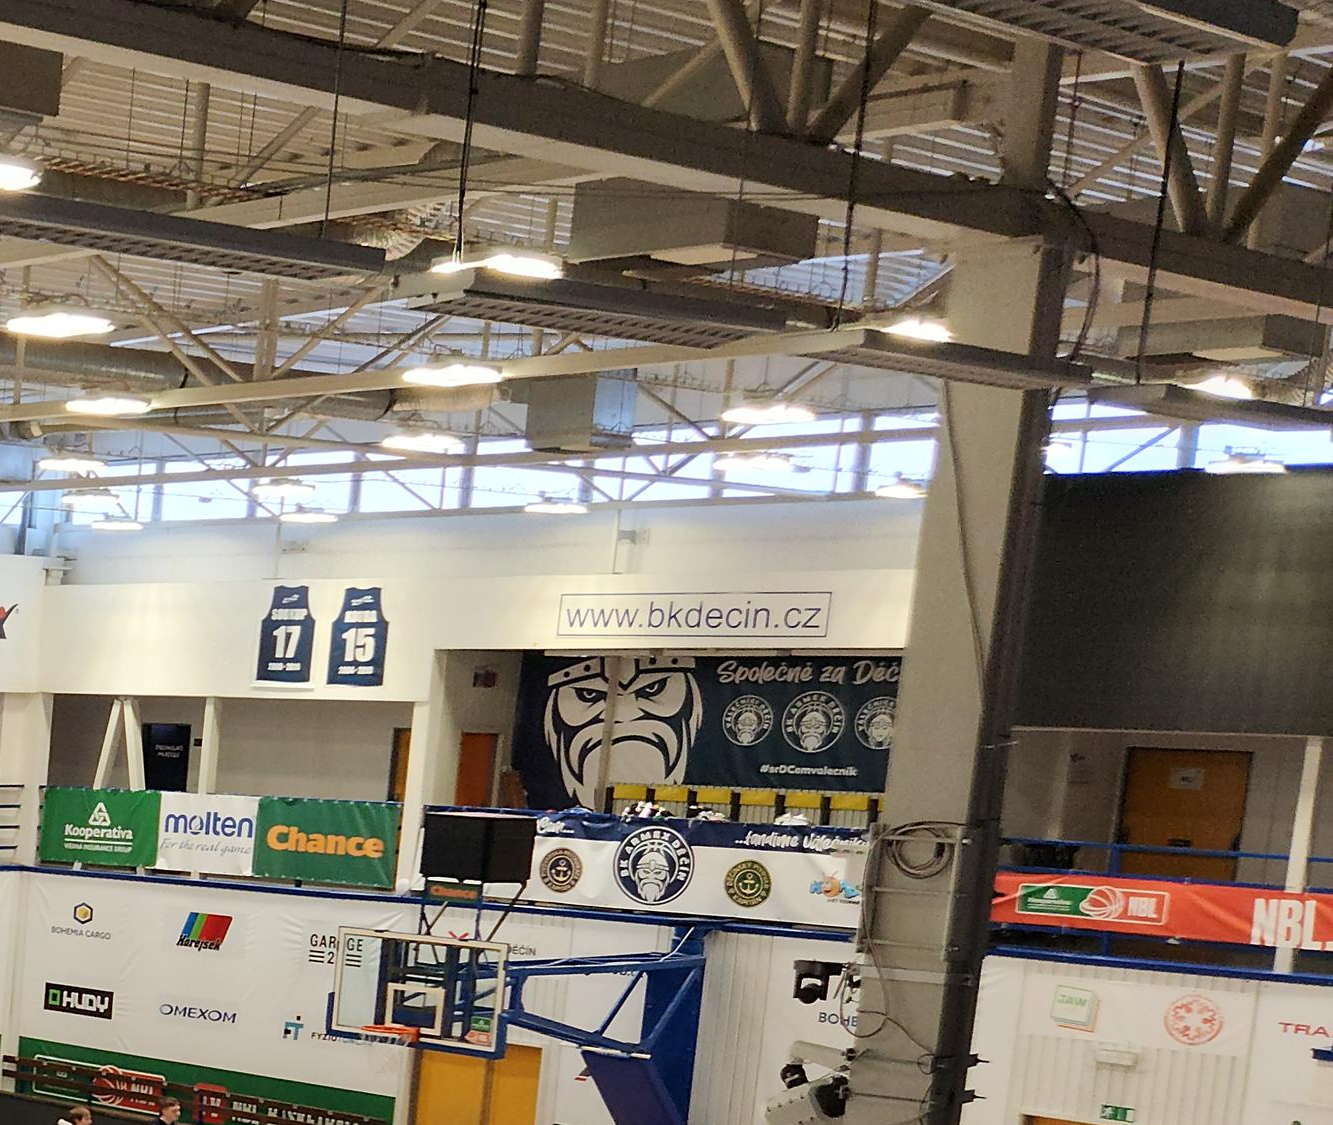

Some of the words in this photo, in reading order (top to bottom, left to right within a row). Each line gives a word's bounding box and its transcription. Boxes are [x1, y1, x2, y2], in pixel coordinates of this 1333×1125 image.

[566, 600, 822, 629] www.bkdecin.cz
[272, 625, 302, 658] 17
[341, 627, 376, 662] 15
[819, 665, 845, 686] za
[853, 659, 900, 684] Děč
[64, 823, 133, 841] Kooperativa
[165, 811, 253, 839] molten
[267, 824, 384, 858] Chance
[625, 830, 671, 855] ARMEX
[1128, 896, 1158, 918] NBL
[51, 926, 84, 938] BOHEMIA
[85, 928, 112, 940] CARGO
[310, 933, 363, 952] GARGE
[62, 991, 110, 1013] HUDY
[159, 1003, 238, 1024] OMEXOM
[818, 1011, 859, 1028] BOHE
[1278, 1022, 1332, 1038] TRA
